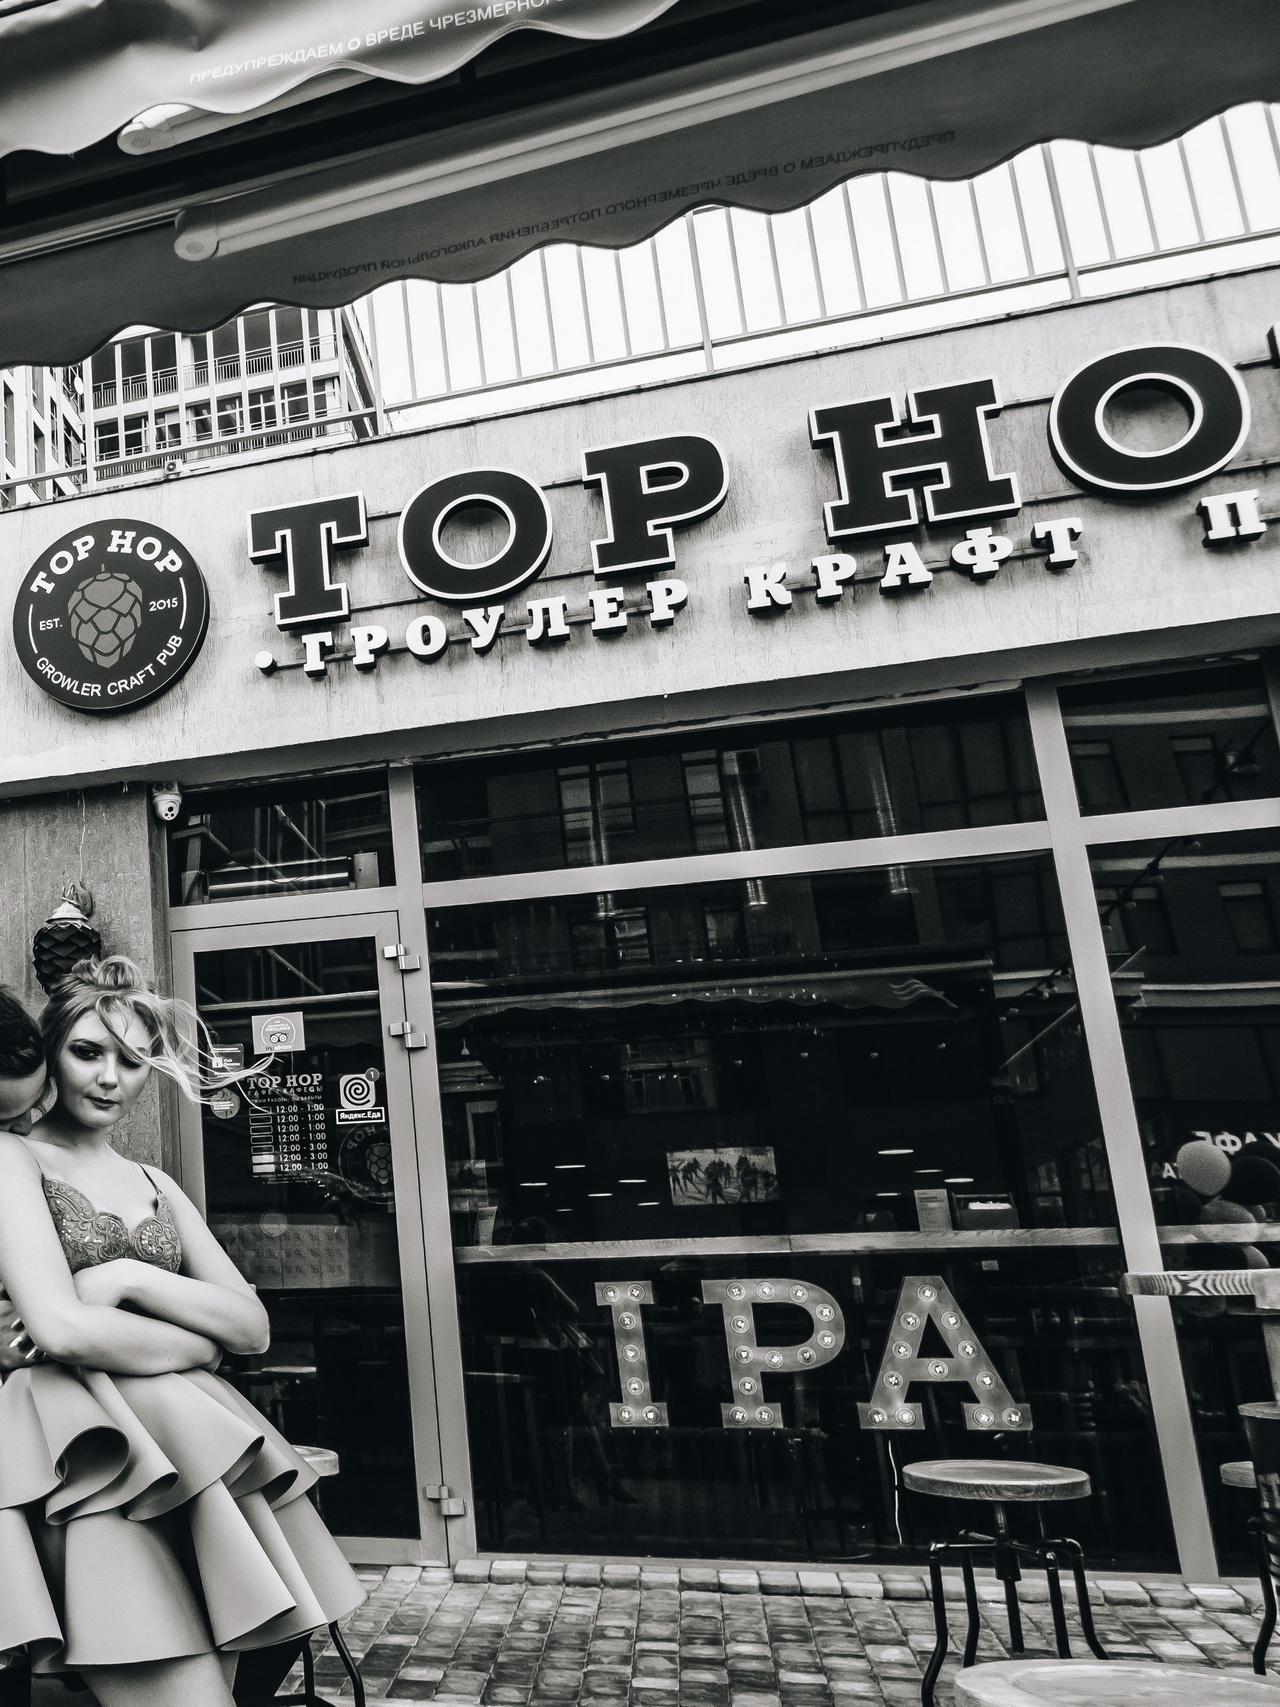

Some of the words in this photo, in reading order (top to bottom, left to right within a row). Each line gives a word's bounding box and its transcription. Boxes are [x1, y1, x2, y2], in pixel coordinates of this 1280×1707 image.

[189, 42, 343, 84] ПРЕДУПРЕЖДАЕМ
[347, 37, 362, 51] О
[366, 21, 425, 47] ВРЕДЕ
[247, 433, 729, 629] TOP
[807, 322, 1280, 545] HO
[29, 535, 95, 594] TOP
[106, 530, 183, 573] HOP
[302, 578, 689, 676] ГРОУЛЕР
[744, 517, 1083, 614] КРАФТ
[1197, 489, 1267, 547] П
[149, 597, 179, 611] 2015
[39, 618, 63, 631] EST.
[36, 657, 101, 697] GROWLER
[107, 663, 156, 696] CRAFT
[156, 634, 183, 666] PUB
[247, 1075, 281, 1090] TOP
[286, 1073, 323, 1087] HOP
[370, 1071, 374, 1079] 1
[276, 1105, 298, 1113] 12:00
[307, 1103, 324, 1111] 1:00
[277, 1115, 298, 1123] 12:00
[308, 1113, 325, 1121] 1:00
[277, 1124, 299, 1132] 12:00
[278, 1134, 300, 1142] 12:00
[309, 1132, 326, 1140] 1:00
[279, 1144, 300, 1152] 12:00
[309, 1142, 327, 1151] 3:00
[280, 1153, 301, 1162] 12:00
[310, 1152, 328, 1160] 3:00
[280, 1163, 302, 1171] 12:00
[311, 1162, 328, 1170] 1:00
[594, 1276, 1033, 1430] IPA
